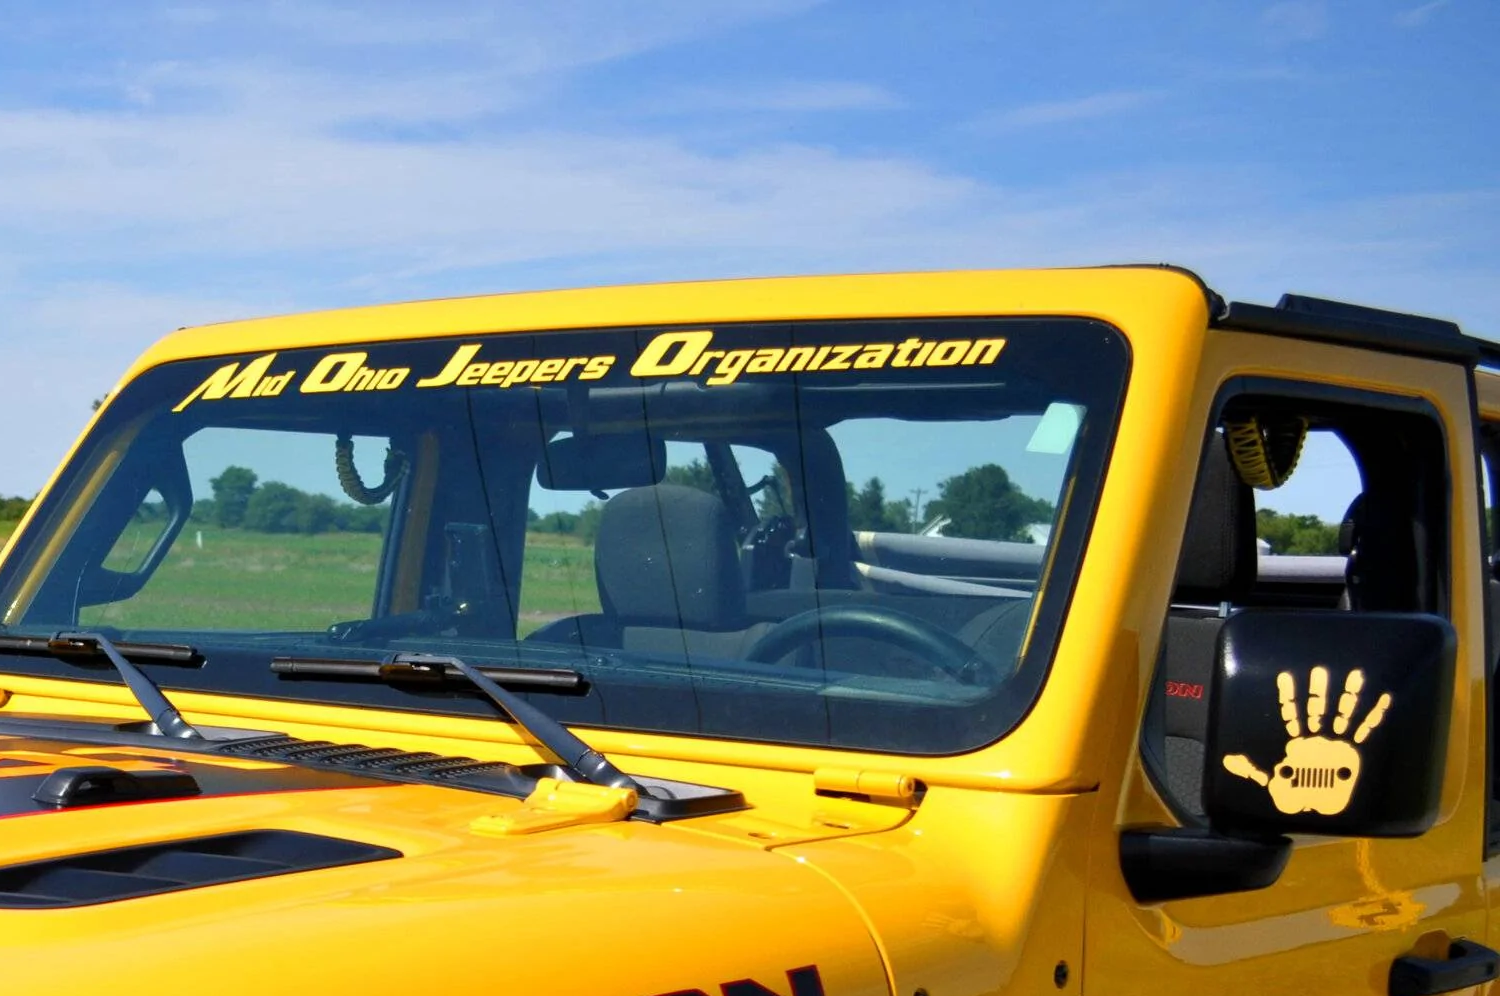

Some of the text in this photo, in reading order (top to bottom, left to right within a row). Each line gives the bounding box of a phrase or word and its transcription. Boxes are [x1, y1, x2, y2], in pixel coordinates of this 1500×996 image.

[171, 331, 1007, 412] Mid Ohio Jeepers Organization
